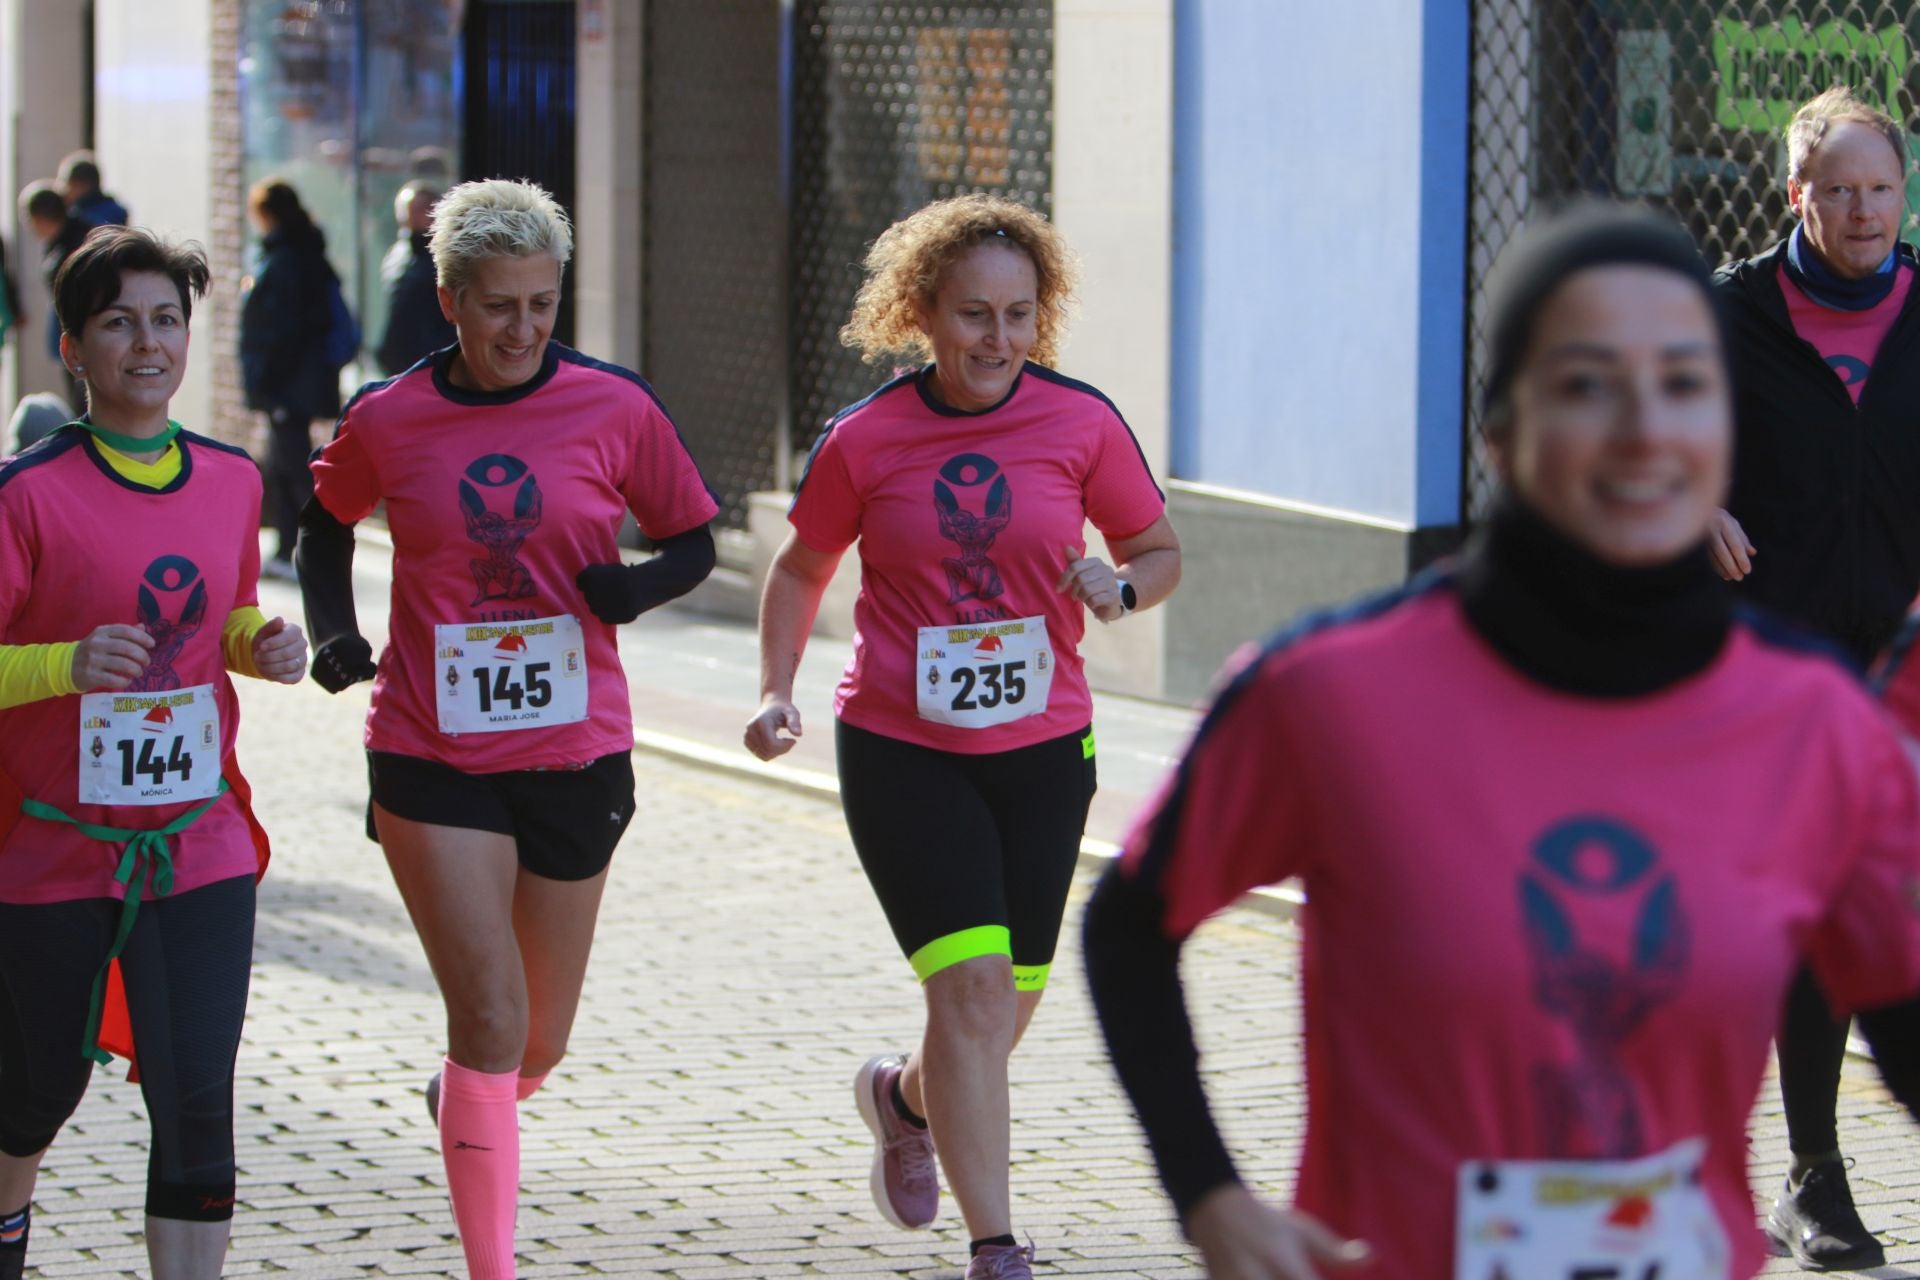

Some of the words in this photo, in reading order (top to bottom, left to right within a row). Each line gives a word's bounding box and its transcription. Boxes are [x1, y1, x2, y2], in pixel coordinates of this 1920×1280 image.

[439, 646, 464, 658] LLENA
[921, 648, 946, 659] LLENA
[473, 662, 552, 712] 145
[950, 660, 1026, 711] 235
[84, 715, 111, 729] LLENA
[489, 714, 518, 723] MARIA
[519, 712, 540, 720] JOSE
[117, 735, 193, 786] 144
[140, 788, 174, 797] MÓNICA
